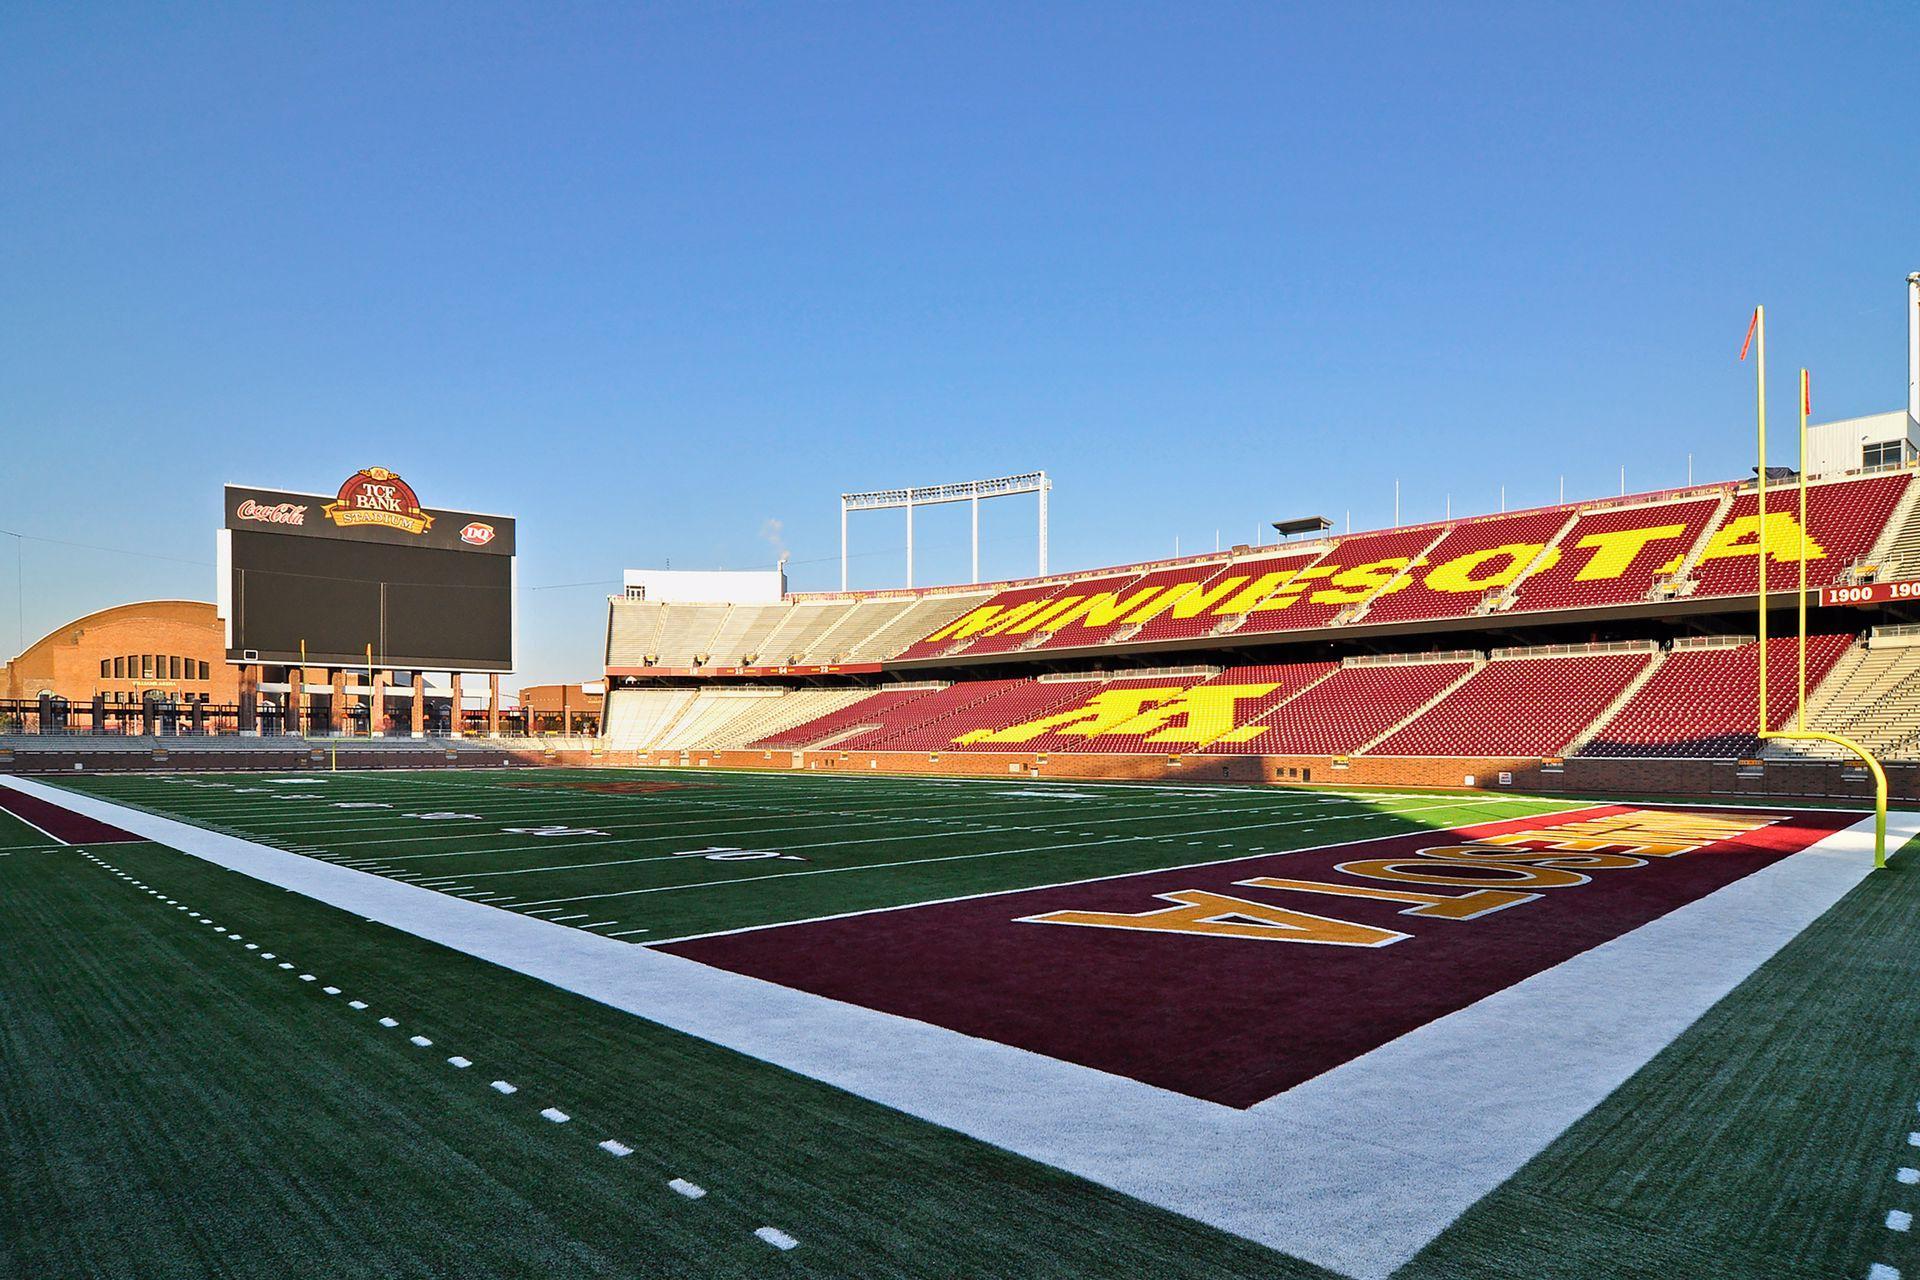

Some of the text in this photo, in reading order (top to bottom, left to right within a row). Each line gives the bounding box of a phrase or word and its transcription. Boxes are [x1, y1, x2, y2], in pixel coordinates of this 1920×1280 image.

[362, 483, 396, 499] TCF
[355, 494, 402, 512] BANK
[237, 499, 308, 526] Coca-Cola
[343, 511, 414, 529] STADIUM
[467, 527, 489, 541] DQ
[927, 511, 1828, 643] MINNESOTA
[1829, 586, 1873, 603] 1900
